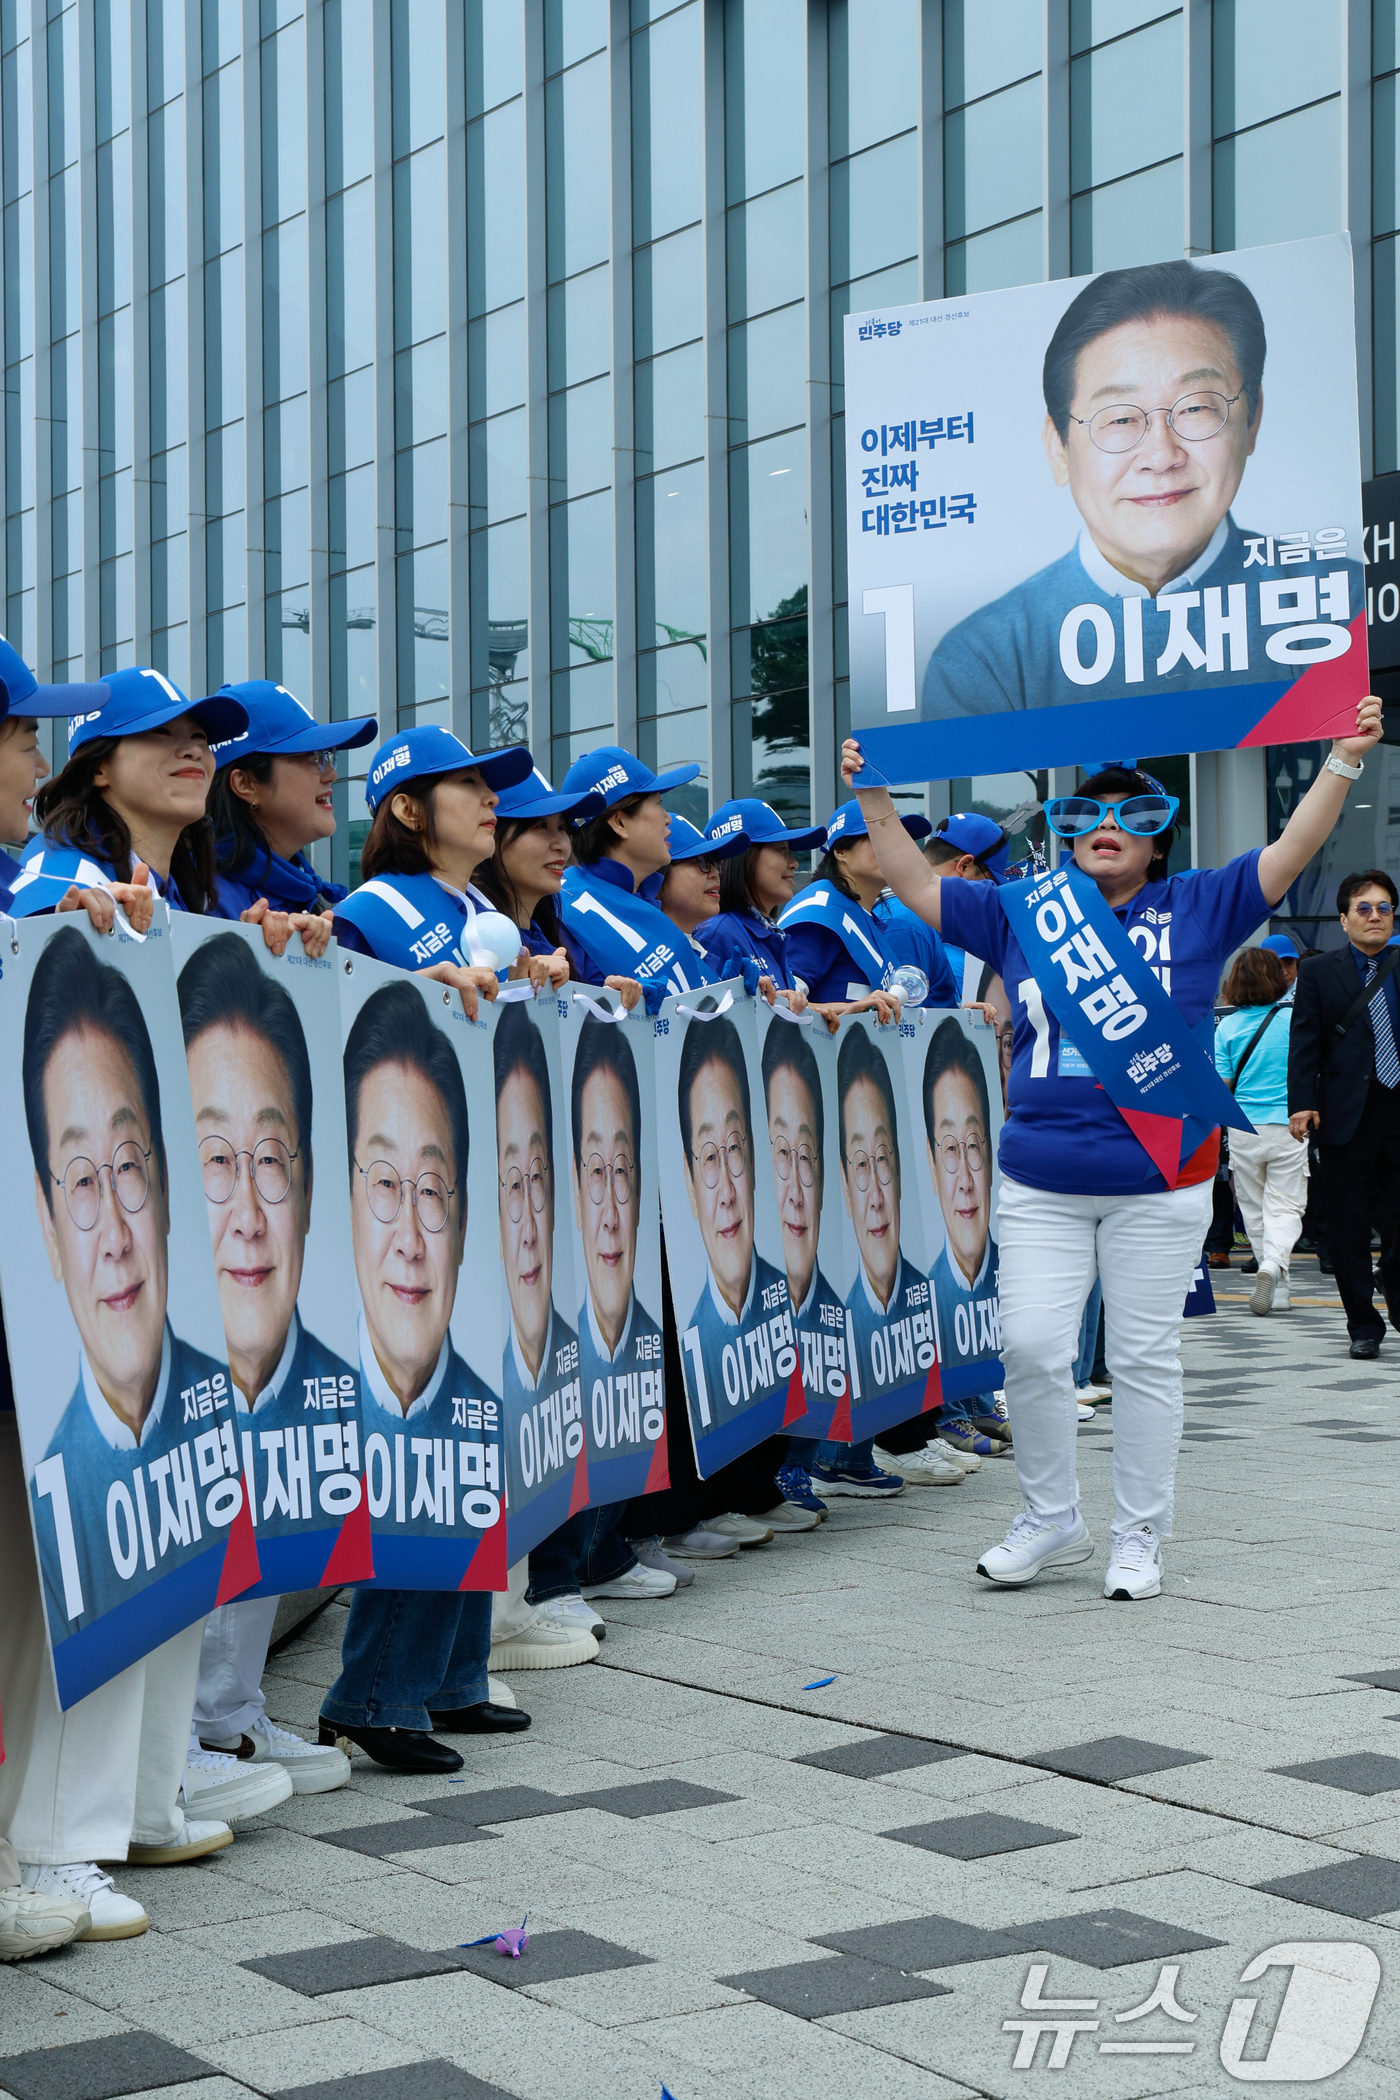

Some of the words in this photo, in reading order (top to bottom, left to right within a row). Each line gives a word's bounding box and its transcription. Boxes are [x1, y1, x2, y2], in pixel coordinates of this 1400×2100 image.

[858, 320, 902, 341] 민주당
[860, 412, 975, 456] 이제부터
[861, 460, 919, 497] 진짜
[861, 493, 977, 536] 대한민국
[1242, 527, 1349, 569] 지금은
[862, 583, 916, 713] 1
[1058, 570, 1353, 686] 이재명
[372, 750, 411, 785] 이재명
[711, 819, 743, 841] 이재명
[1024, 871, 1068, 909] 지금은
[408, 922, 453, 964] 지금은
[570, 891, 648, 954] 1
[633, 944, 675, 979] 지금은
[1035, 884, 1148, 1042] 이재명
[557, 999, 568, 1019] 주당
[1018, 976, 1050, 1078] 1
[1125, 1042, 1174, 1084] 민주당
[761, 1279, 787, 1312] 지금은
[905, 1281, 929, 1308] 지금은
[819, 1303, 844, 1329] 지금은
[954, 1297, 1004, 1356] 이재
[556, 1340, 579, 1377] 지금은
[635, 1333, 662, 1362] 지금은
[683, 1325, 712, 1428] 1
[721, 1309, 798, 1407] 이재명
[795, 1329, 847, 1398] 재명
[870, 1308, 936, 1387] 이재명
[180, 1371, 229, 1425] 지금은
[303, 1374, 357, 1411] 지금은
[591, 1368, 665, 1450] 이재명
[450, 1397, 498, 1432] 지금은
[519, 1376, 584, 1490] 이재명
[365, 1431, 502, 1530] 이재명
[33, 1452, 86, 1622] 1
[105, 1419, 245, 1581] 이재명
